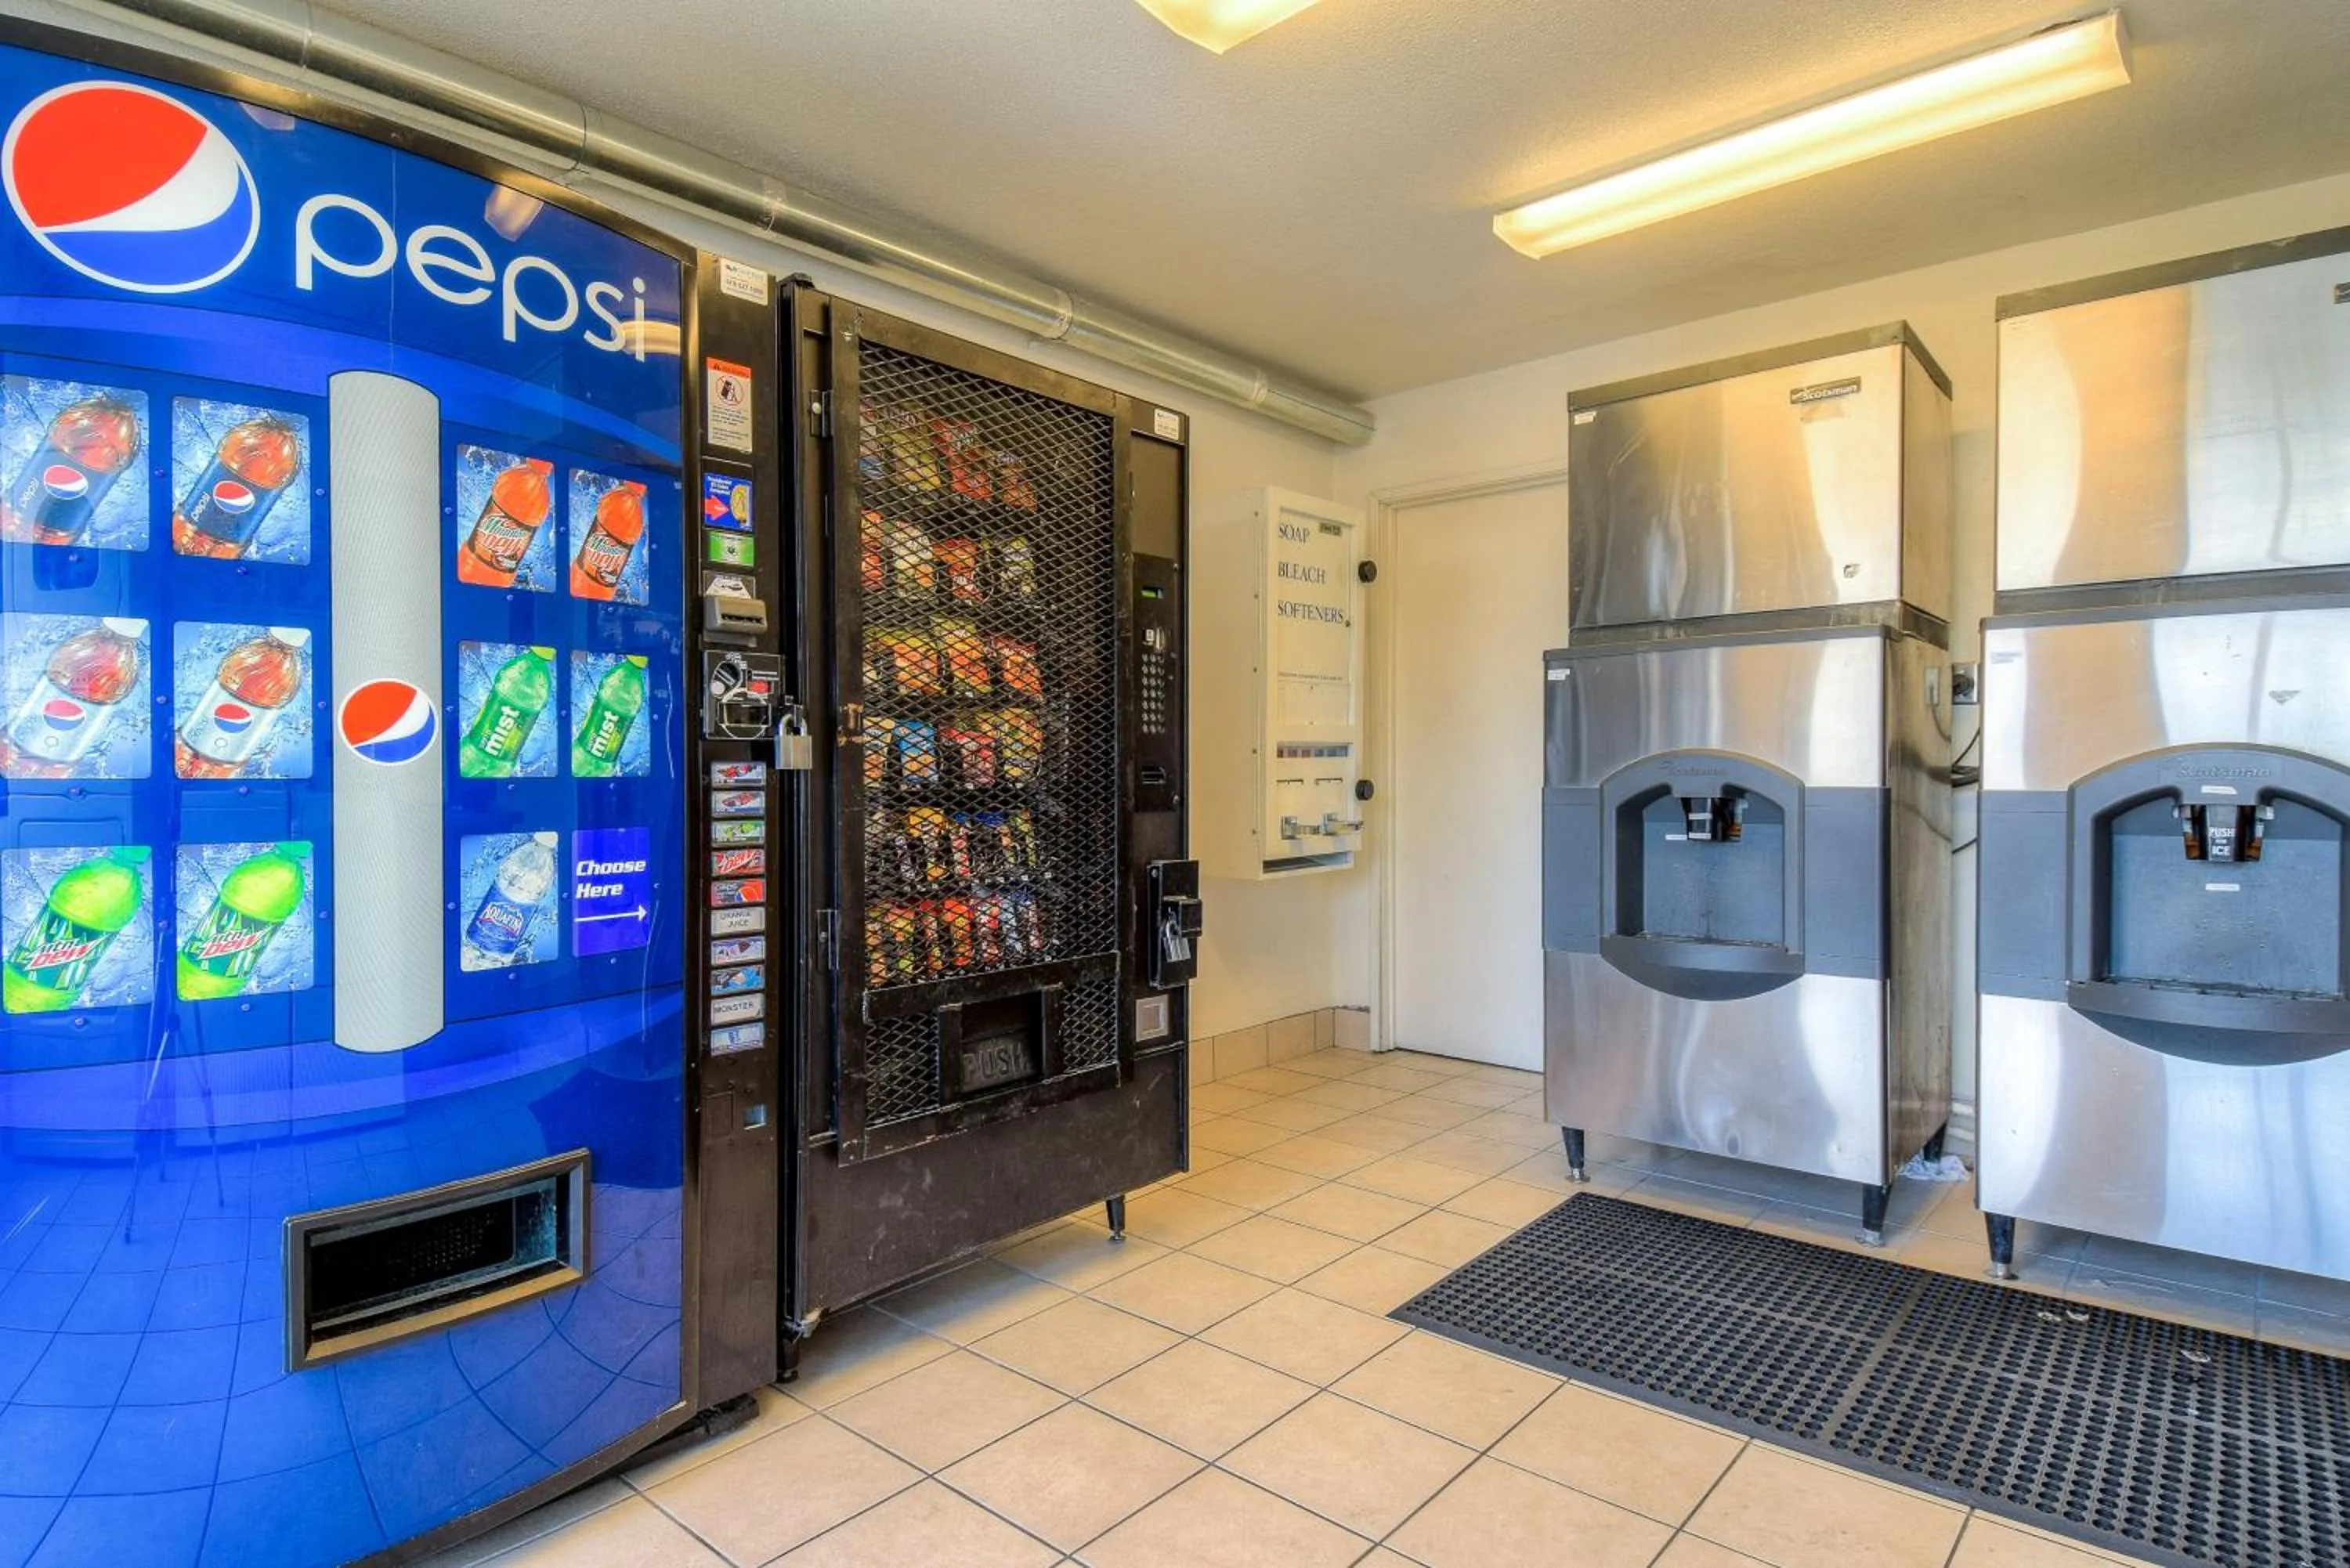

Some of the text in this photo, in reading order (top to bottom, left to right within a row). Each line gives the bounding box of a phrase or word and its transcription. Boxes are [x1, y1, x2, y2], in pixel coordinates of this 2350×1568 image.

[296, 193, 646, 363] pepsi
[20, 477, 39, 509] pepsi
[190, 492, 211, 522] pepsi
[1278, 522, 1311, 544] SOAP
[1278, 561, 1326, 584] BLEACH
[1278, 600, 1344, 624] SOFTENERS
[485, 706, 520, 756] mist
[591, 710, 619, 758] mist
[2209, 827, 2236, 837] PUSH
[2212, 846, 2230, 856] ICE
[576, 860, 646, 876] Choose
[576, 883, 624, 898] Here
